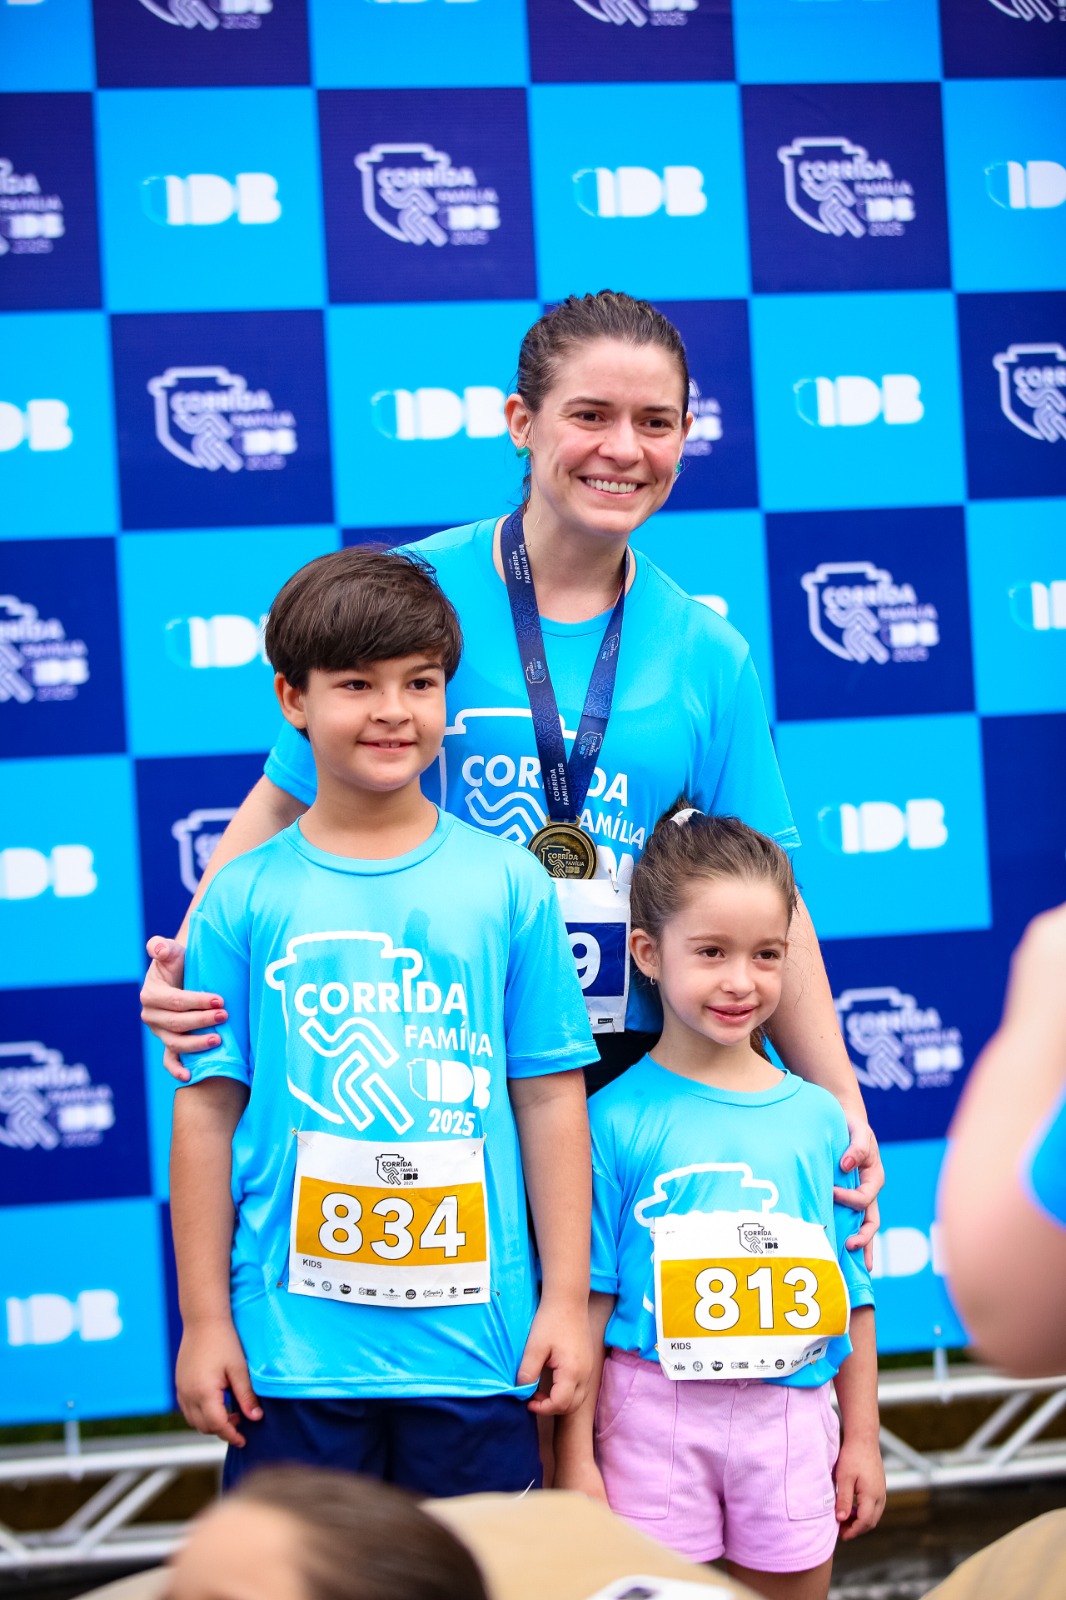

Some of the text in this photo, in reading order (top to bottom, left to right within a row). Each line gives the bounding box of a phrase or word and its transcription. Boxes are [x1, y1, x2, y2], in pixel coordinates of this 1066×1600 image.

[376, 165, 478, 188] CORRIDA
[797, 159, 894, 181] CORRIDA
[165, 172, 282, 226] IDB
[596, 165, 708, 218] IDB
[170, 389, 274, 413] CORRIDA
[816, 373, 925, 427] IDB
[512, 550, 522, 580] CORRIDA
[821, 583, 918, 606] CORRIDA
[189, 613, 270, 668] ID
[462, 754, 629, 808] CORDA
[550, 768, 561, 801] CORRIDA
[557, 762, 565, 775] IDB
[578, 808, 646, 850] AMÍLIA
[840, 797, 948, 854] IDB
[547, 852, 579, 860] CORRIDA
[294, 980, 468, 1017] CORRIDA
[426, 1058, 491, 1110] IDB
[427, 1107, 476, 1137] 2025
[381, 1160, 412, 1168] CORRIDA
[318, 1191, 466, 1260] 834
[302, 1258, 322, 1269] KIDS
[693, 1265, 822, 1331] 813
[6, 1289, 121, 1345] IDB
[670, 1342, 692, 1350] KIDS
